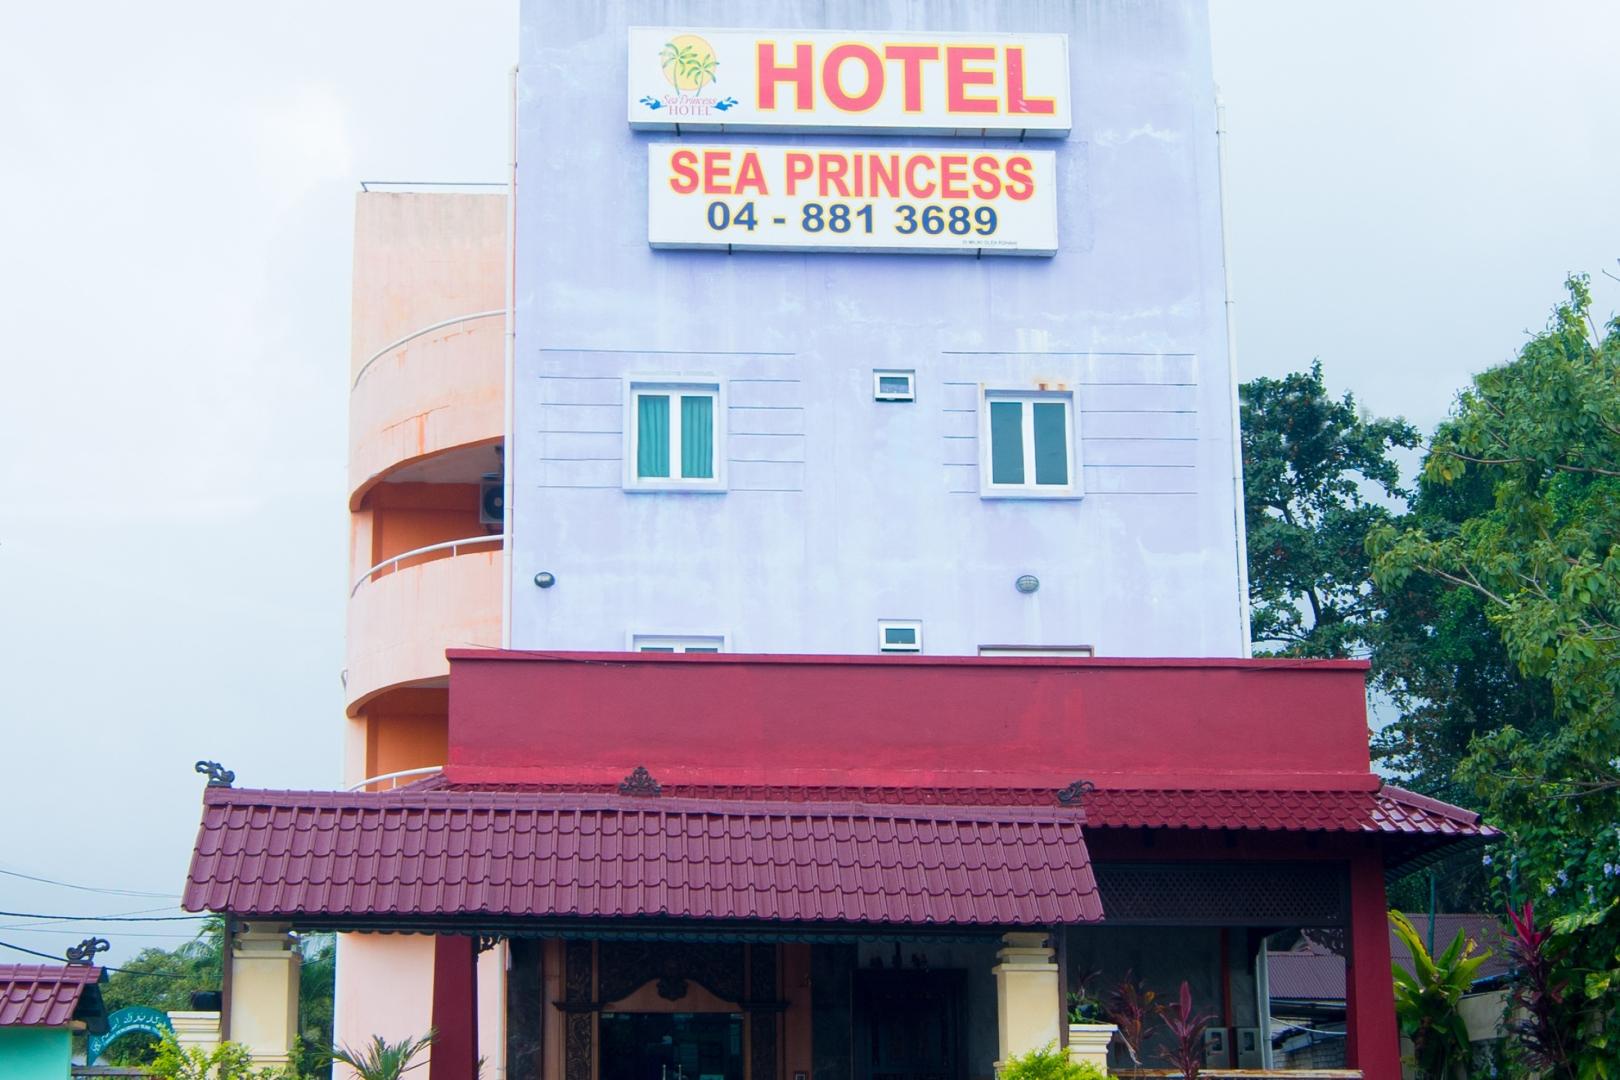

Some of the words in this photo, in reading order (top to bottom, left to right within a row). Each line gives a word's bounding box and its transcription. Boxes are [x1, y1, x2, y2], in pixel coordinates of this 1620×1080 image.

[756, 41, 1057, 115] HOTEL
[662, 94, 678, 104] Sea
[679, 94, 717, 105] Princess
[669, 105, 712, 116] HOTEL
[669, 150, 769, 196] SEA
[785, 152, 1036, 201] PRINCESS
[707, 201, 758, 231] 04
[801, 203, 875, 233] 881
[894, 205, 999, 236] 3689
